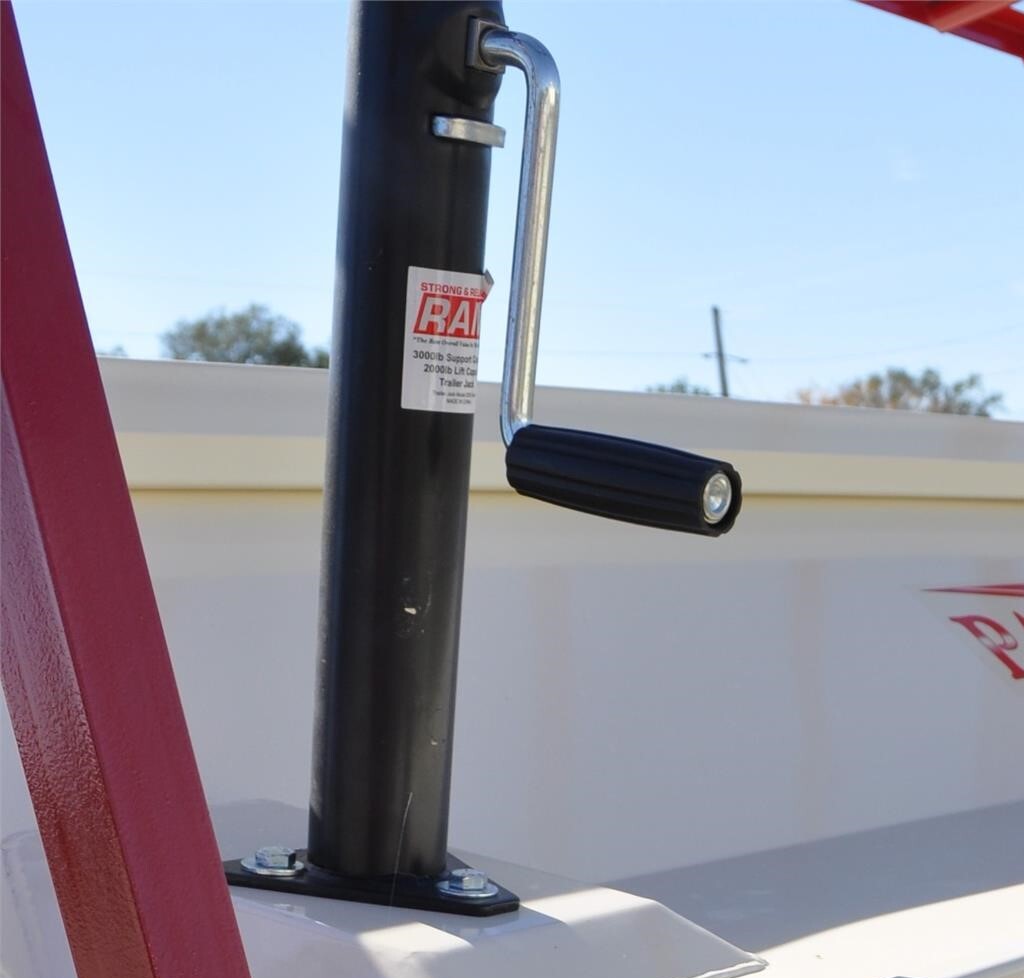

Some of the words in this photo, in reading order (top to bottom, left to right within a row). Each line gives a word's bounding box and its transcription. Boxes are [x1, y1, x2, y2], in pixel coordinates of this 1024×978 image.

[420, 282, 462, 296] STRONG
[463, 287, 469, 296] &
[412, 350, 444, 361] 3000lb
[446, 352, 472, 364] Support
[423, 363, 452, 374] 2000lb
[454, 366, 465, 376] Lift
[439, 377, 463, 388] Trailer
